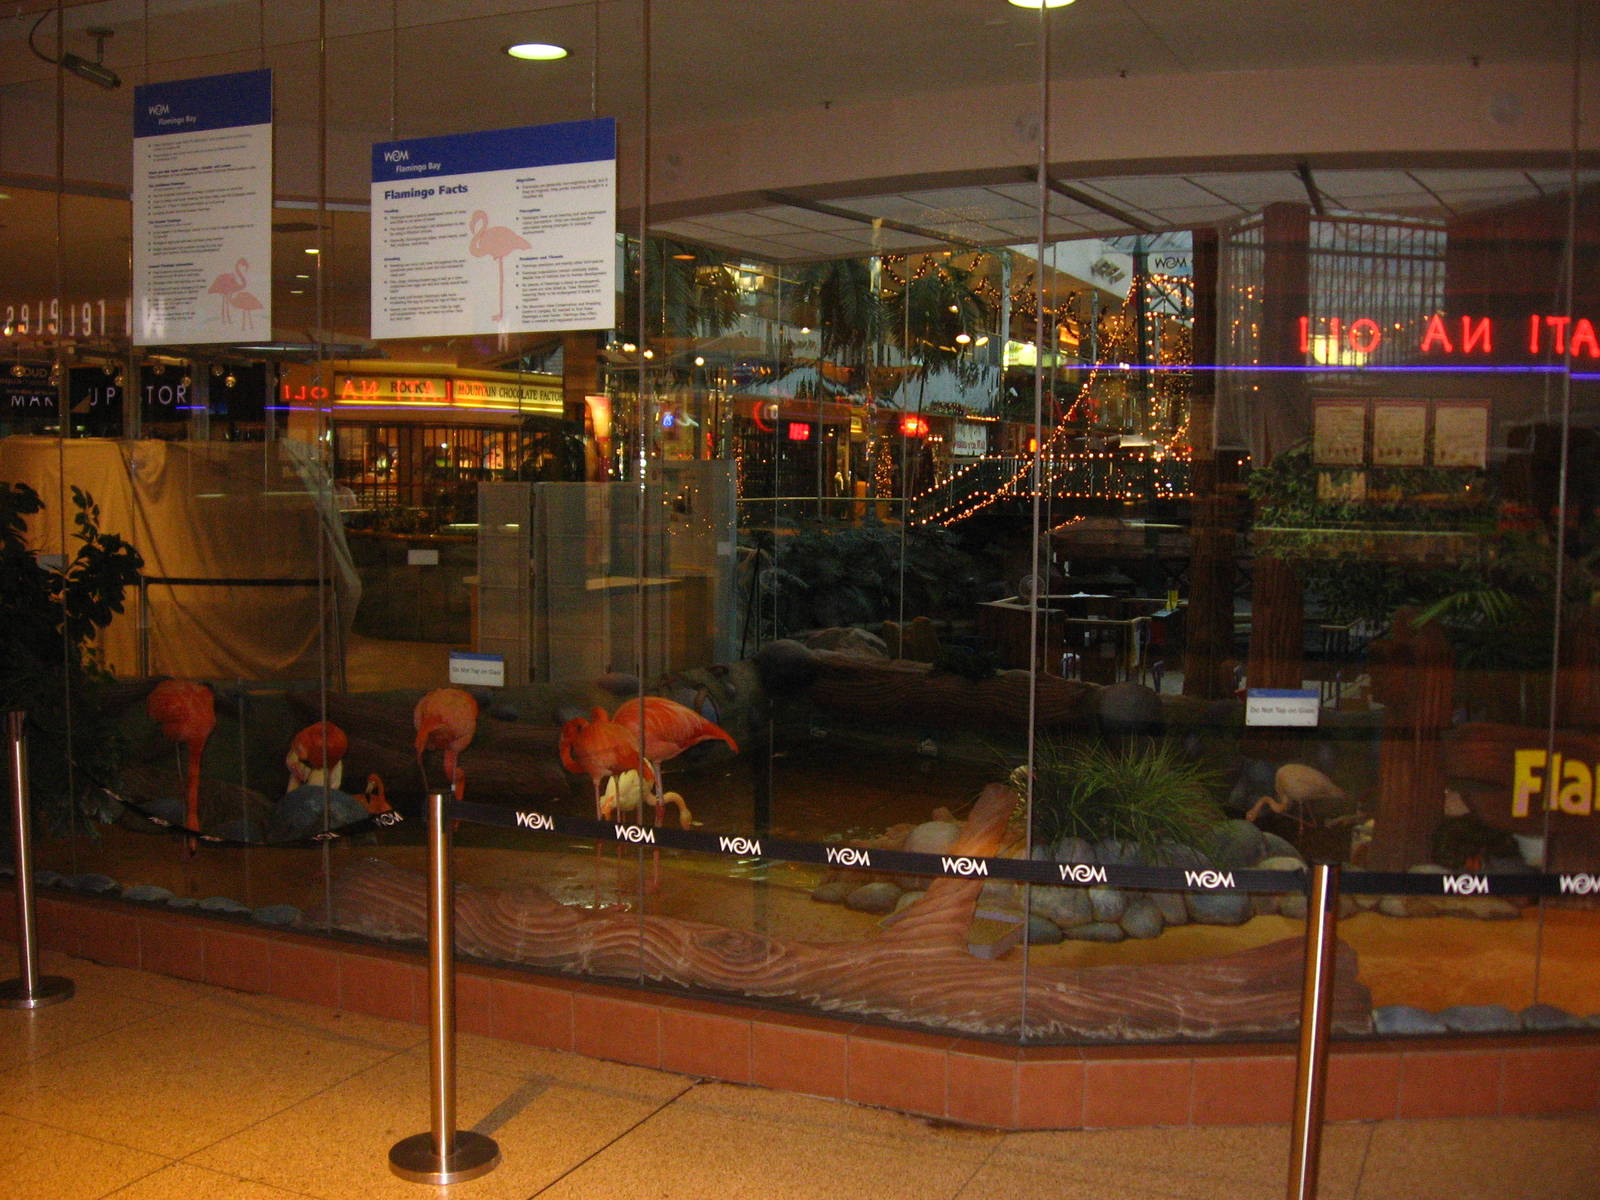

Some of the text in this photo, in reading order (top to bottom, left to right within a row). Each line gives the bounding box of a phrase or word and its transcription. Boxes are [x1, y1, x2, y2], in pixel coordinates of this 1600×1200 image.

[396, 162, 442, 173] Flamingo Bay
[384, 184, 469, 201] Flamingo Facts
[458, 384, 496, 397] MOUNTAIN
[499, 386, 538, 400] CHOCOLATE
[1261, 706, 1274, 714] Not
[1275, 706, 1287, 716] Tap
[1512, 748, 1600, 819] Fla
